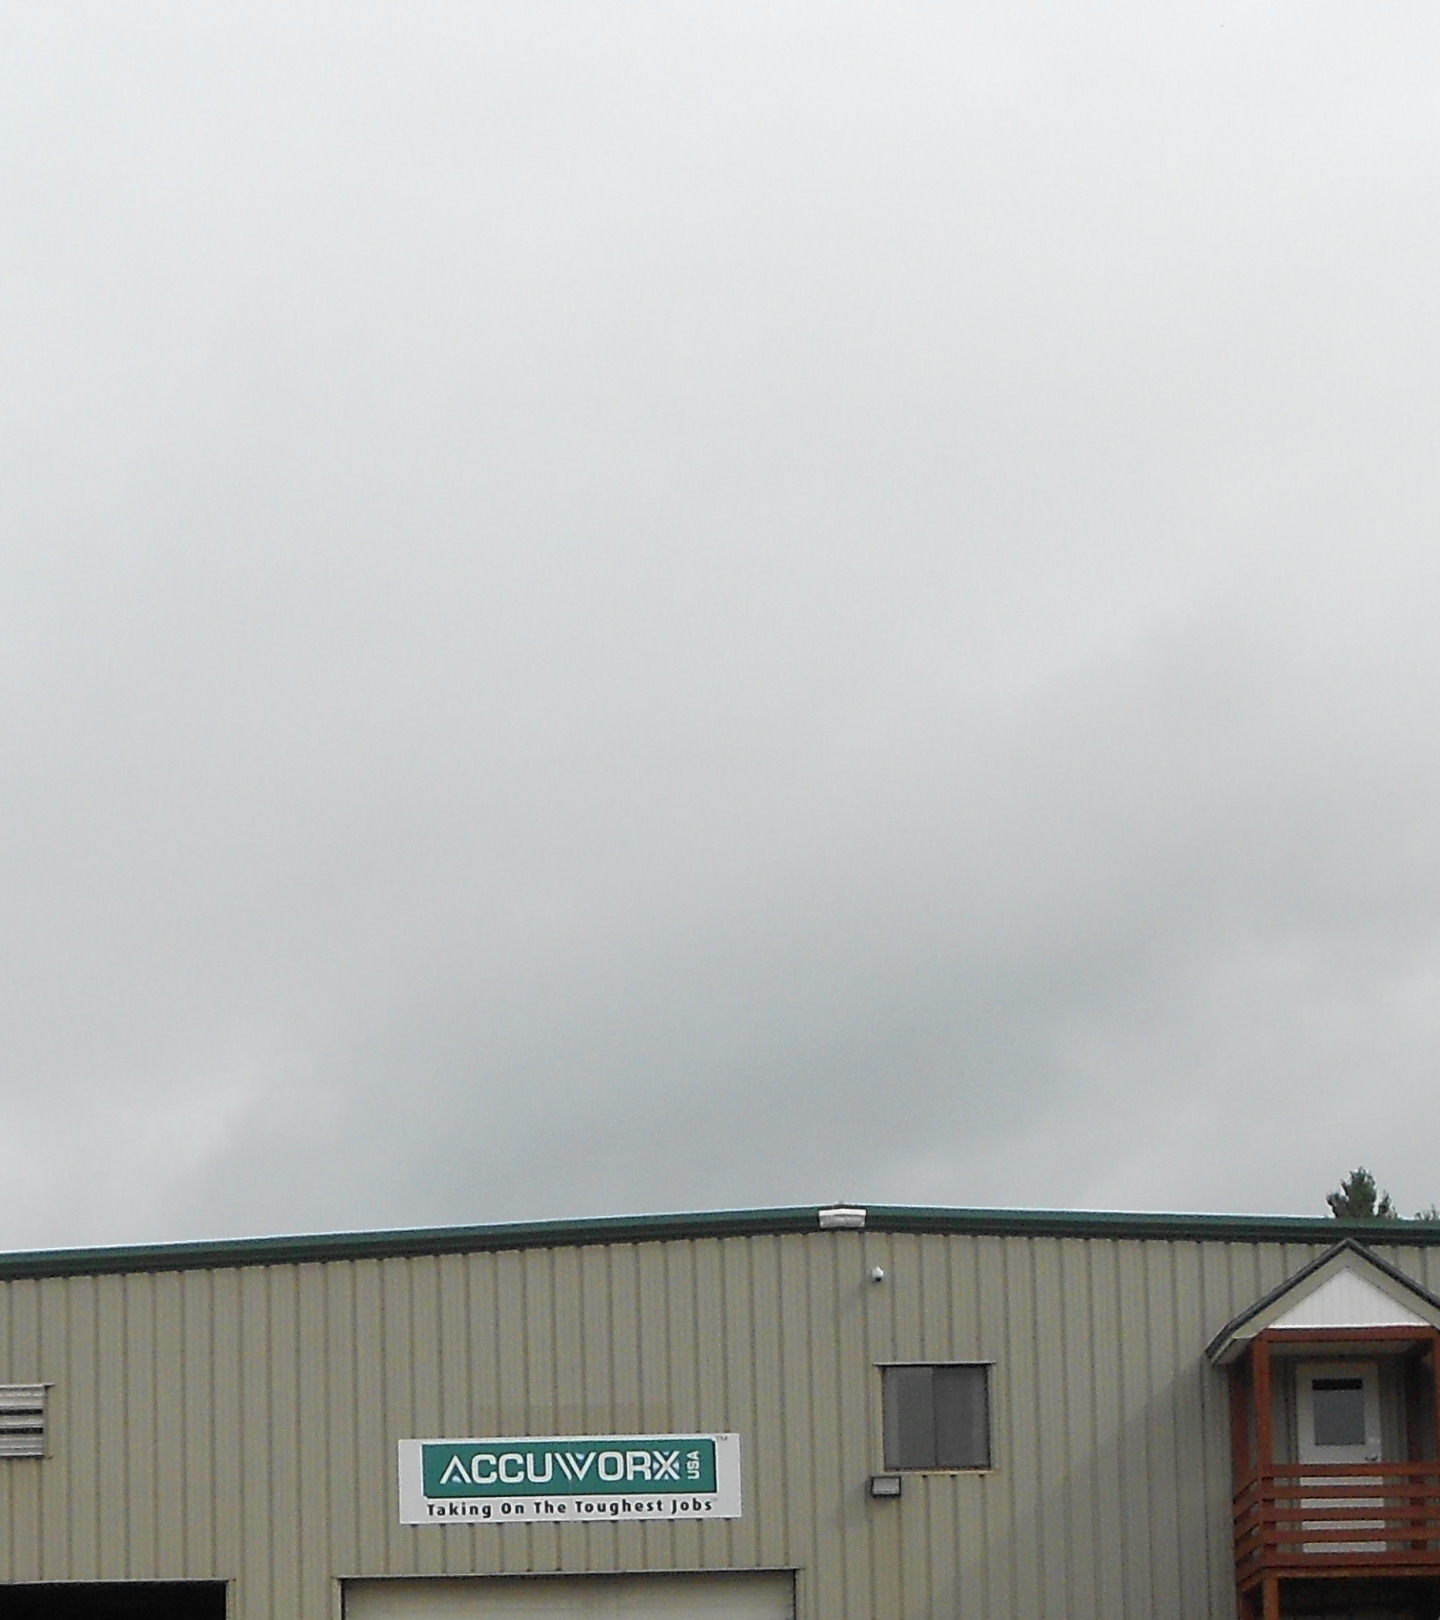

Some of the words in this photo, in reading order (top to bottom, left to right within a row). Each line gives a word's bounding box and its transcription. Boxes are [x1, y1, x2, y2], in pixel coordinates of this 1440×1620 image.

[440, 1451, 680, 1484] ACCUWORX
[687, 1451, 700, 1479] USA
[427, 1502, 491, 1518] Taking
[501, 1502, 524, 1514] On
[534, 1500, 566, 1514] The
[575, 1499, 662, 1516] Toughest
[671, 1498, 712, 1514] Jobs
